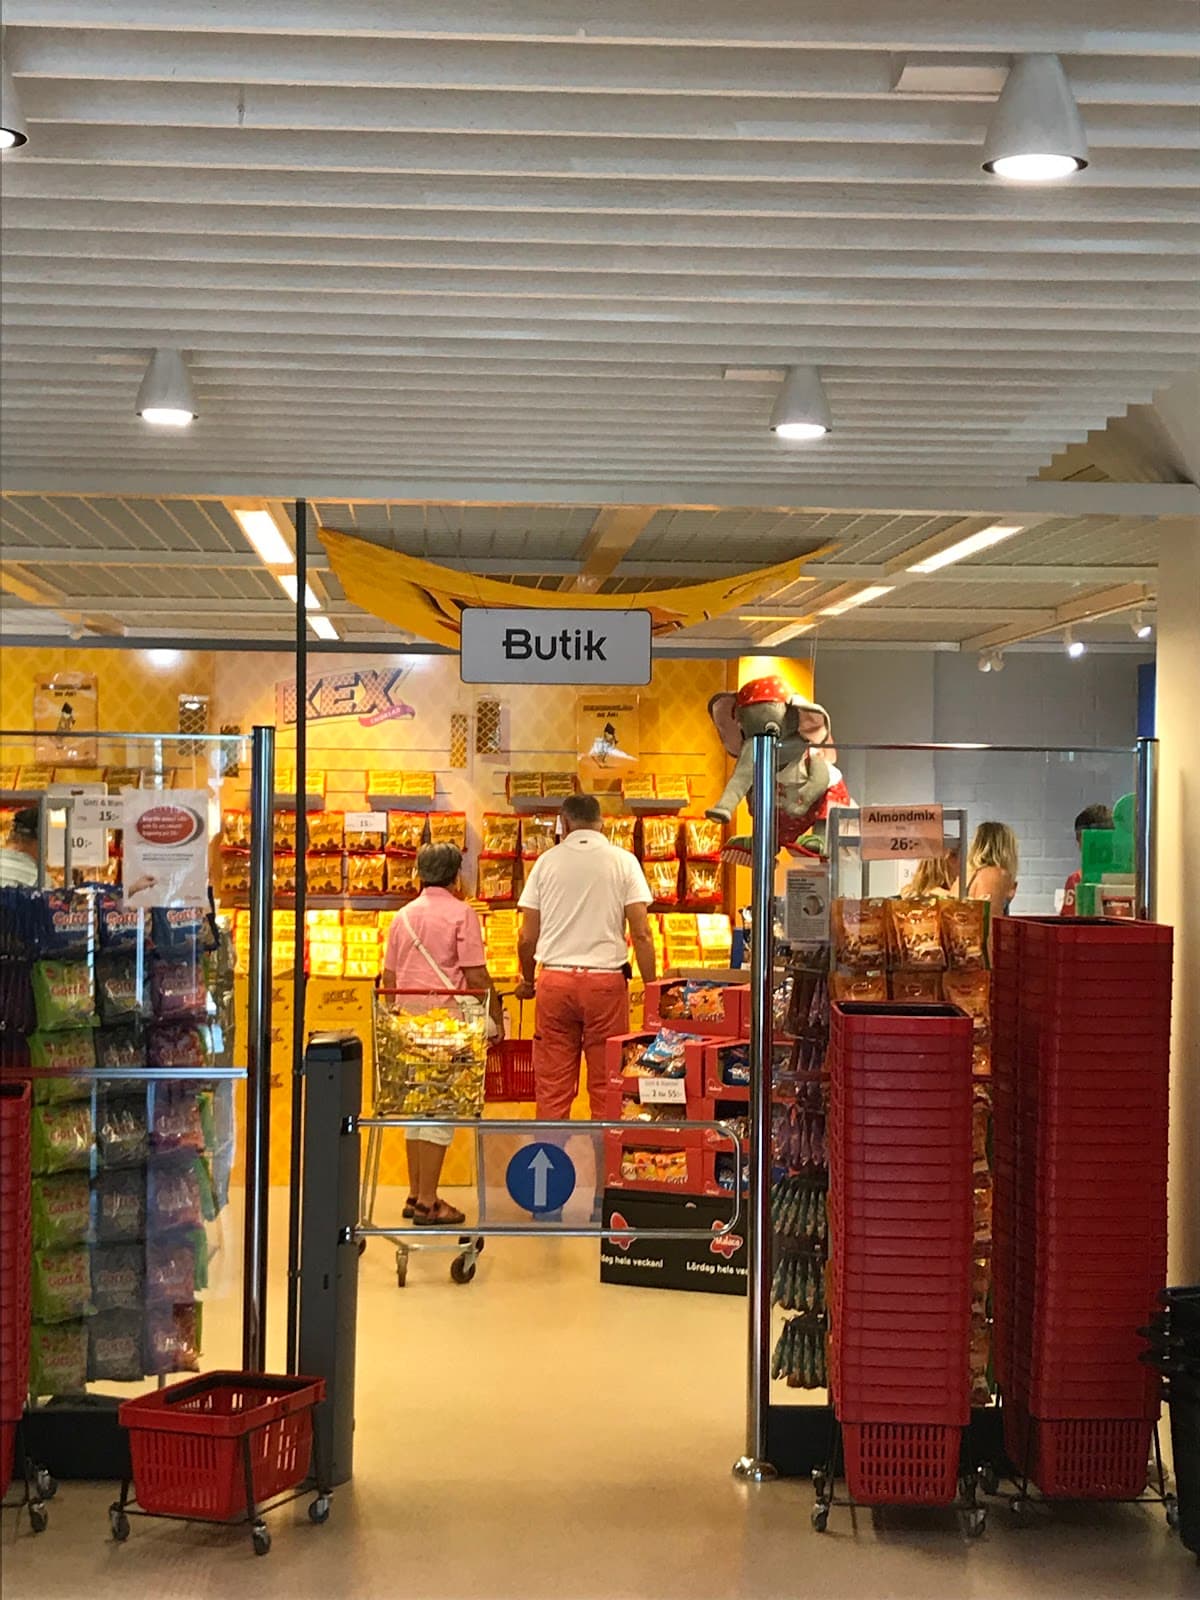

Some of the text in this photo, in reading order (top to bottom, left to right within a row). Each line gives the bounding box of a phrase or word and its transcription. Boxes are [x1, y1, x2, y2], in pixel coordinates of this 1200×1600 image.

[502, 628, 607, 661] Butik
[284, 668, 403, 724] KEX
[99, 810, 120, 822] 15:-
[868, 809, 935, 823] Almondmix
[890, 837, 919, 851] 26:-
[614, 1255, 631, 1266] hela
[686, 1261, 715, 1275] Lördag
[716, 1264, 734, 1275] hela
